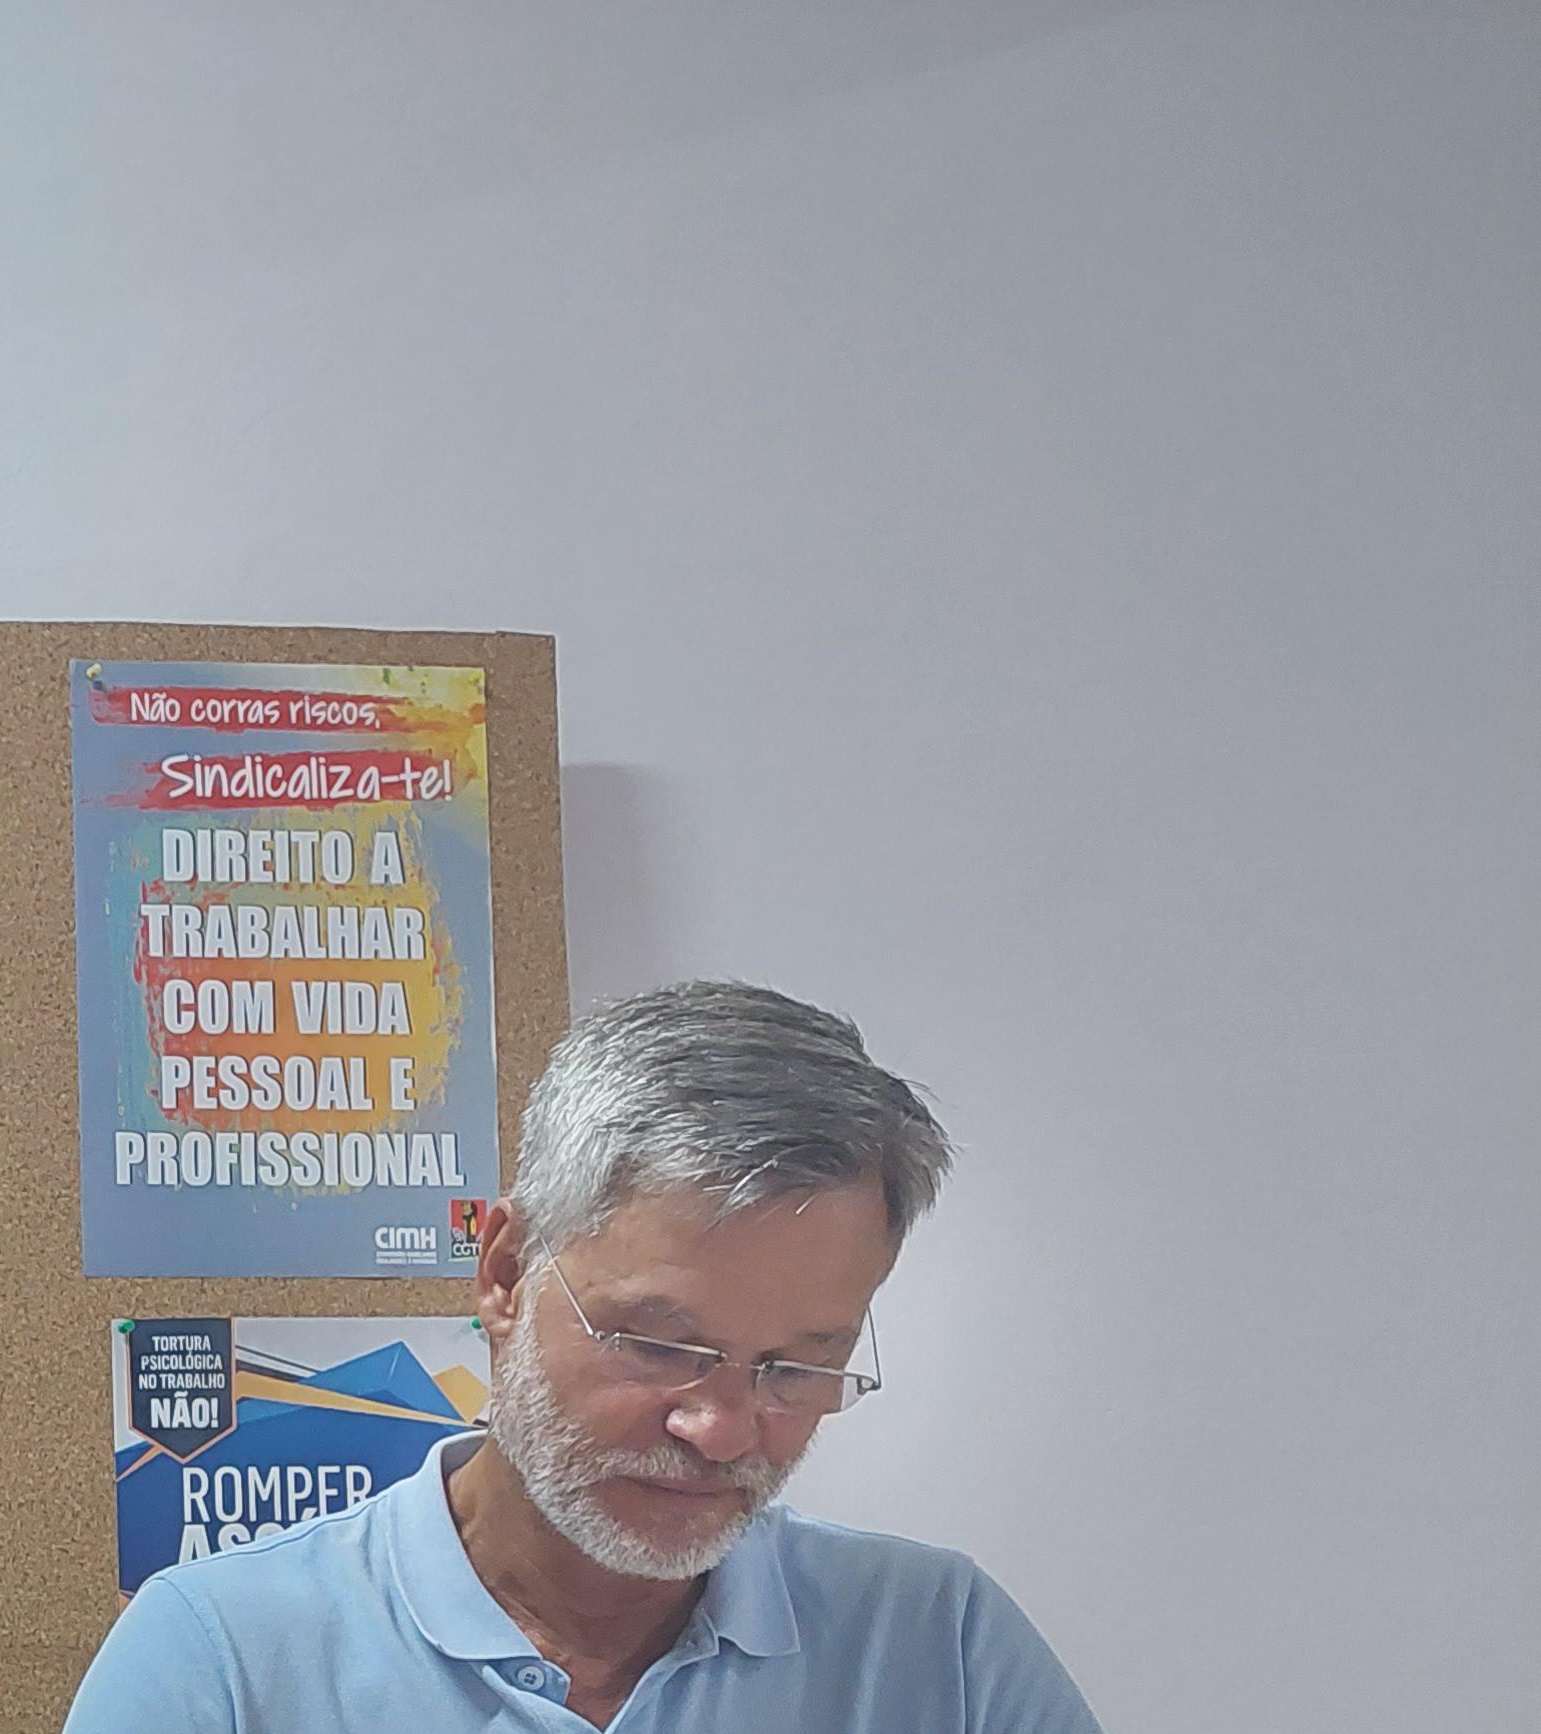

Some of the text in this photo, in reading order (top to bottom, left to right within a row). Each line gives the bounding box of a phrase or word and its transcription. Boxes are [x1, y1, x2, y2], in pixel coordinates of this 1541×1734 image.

[131, 692, 180, 721] Não
[190, 699, 280, 724] corras
[162, 755, 452, 801] Sindicaliza-te!
[162, 828, 406, 885] DIREITO A
[141, 904, 425, 960] TRABALHAR
[163, 980, 412, 1035] COM VIDA
[161, 1056, 415, 1111] PESSOAL E
[116, 1132, 464, 1187] PROFISSIONAL
[375, 1227, 437, 1249] CIMH
[453, 1243, 483, 1256] CGT
[140, 1352, 223, 1370] PSICOLÓGICA
[152, 1335, 212, 1352] TORTURA
[138, 1374, 225, 1390] NO TRABALHO
[150, 1392, 218, 1429] NÃO!
